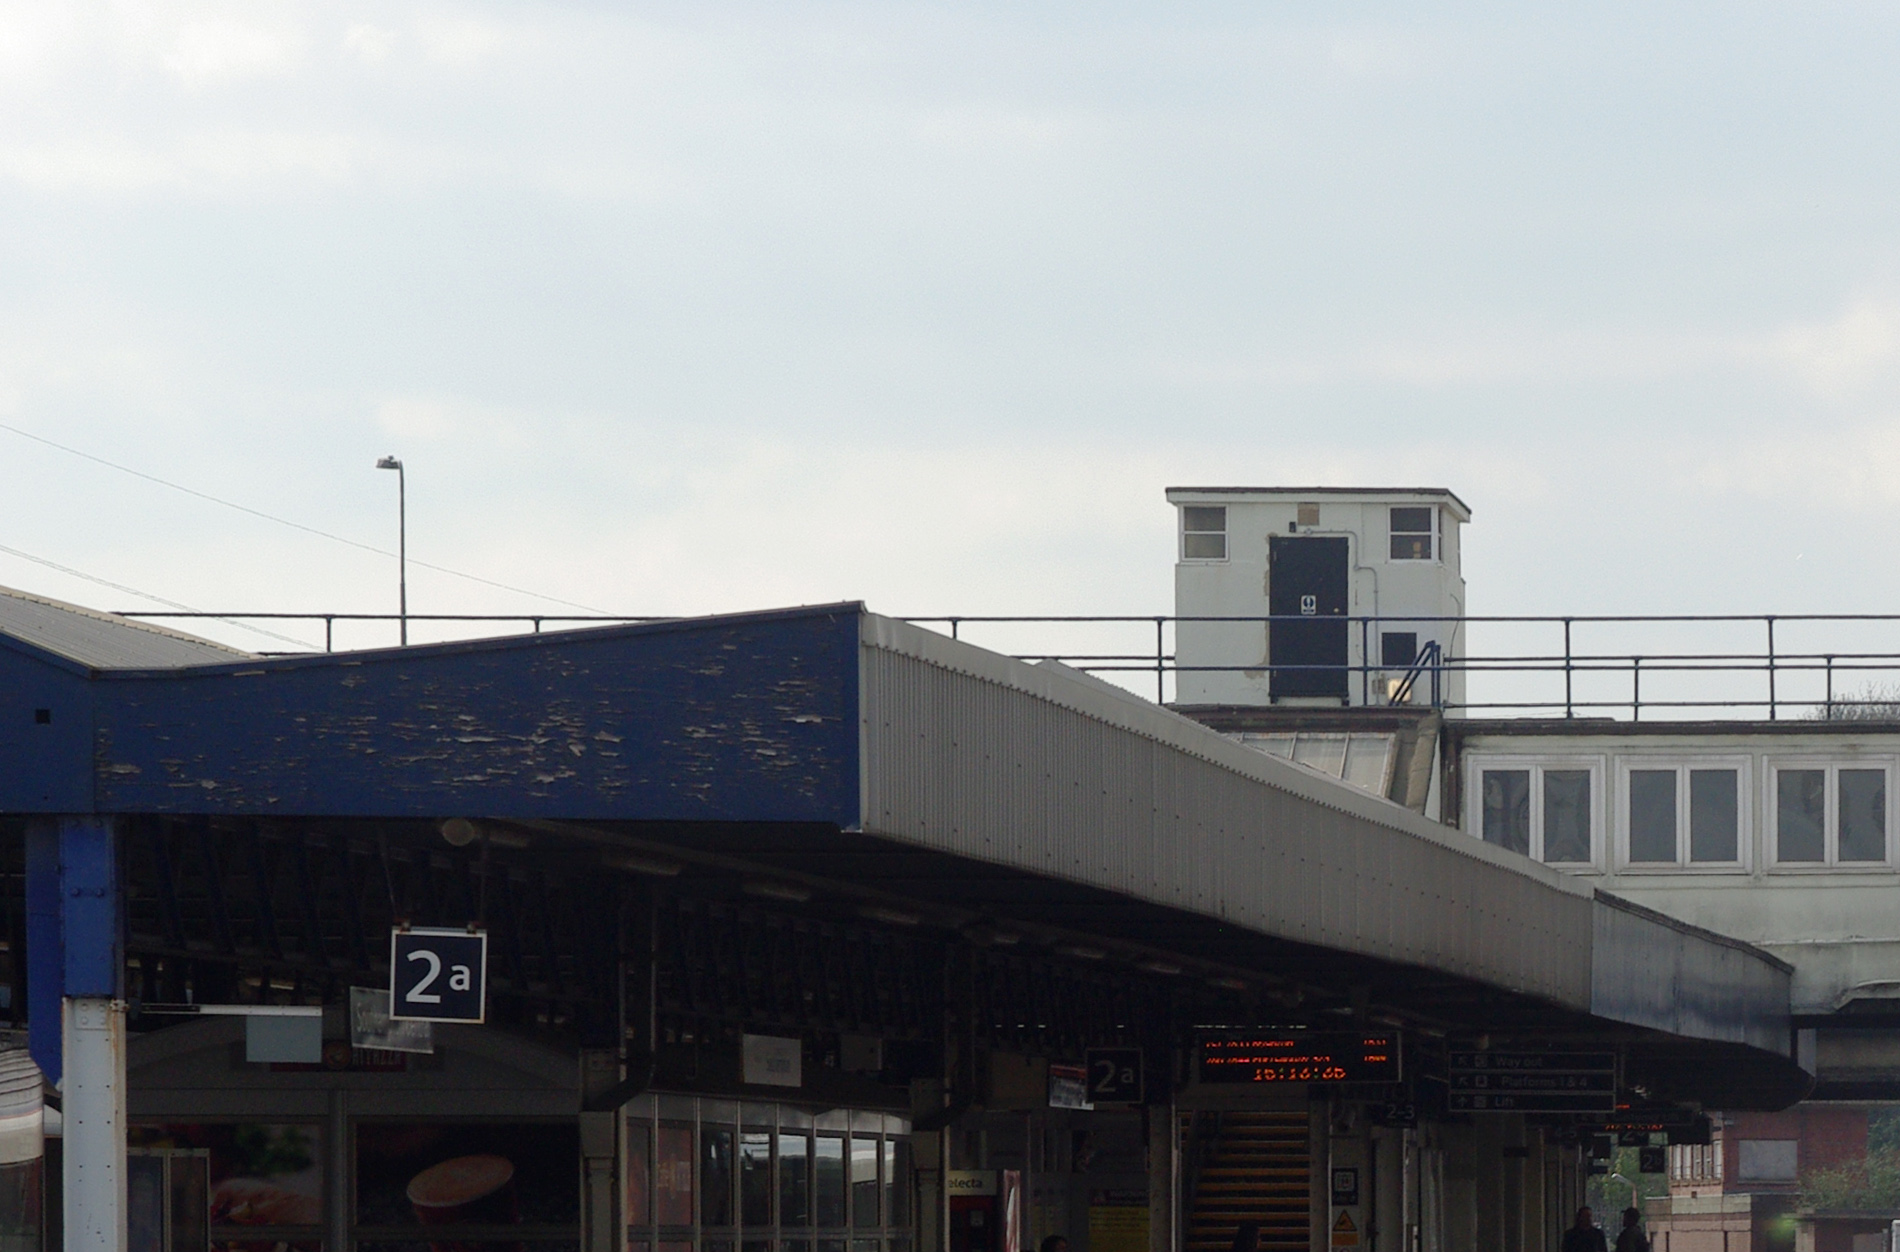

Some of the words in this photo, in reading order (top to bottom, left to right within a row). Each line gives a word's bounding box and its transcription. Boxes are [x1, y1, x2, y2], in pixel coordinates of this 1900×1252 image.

[404, 949, 472, 1004] 2a
[1095, 1060, 1135, 1092] 2a
[948, 1177, 983, 1189] electa
